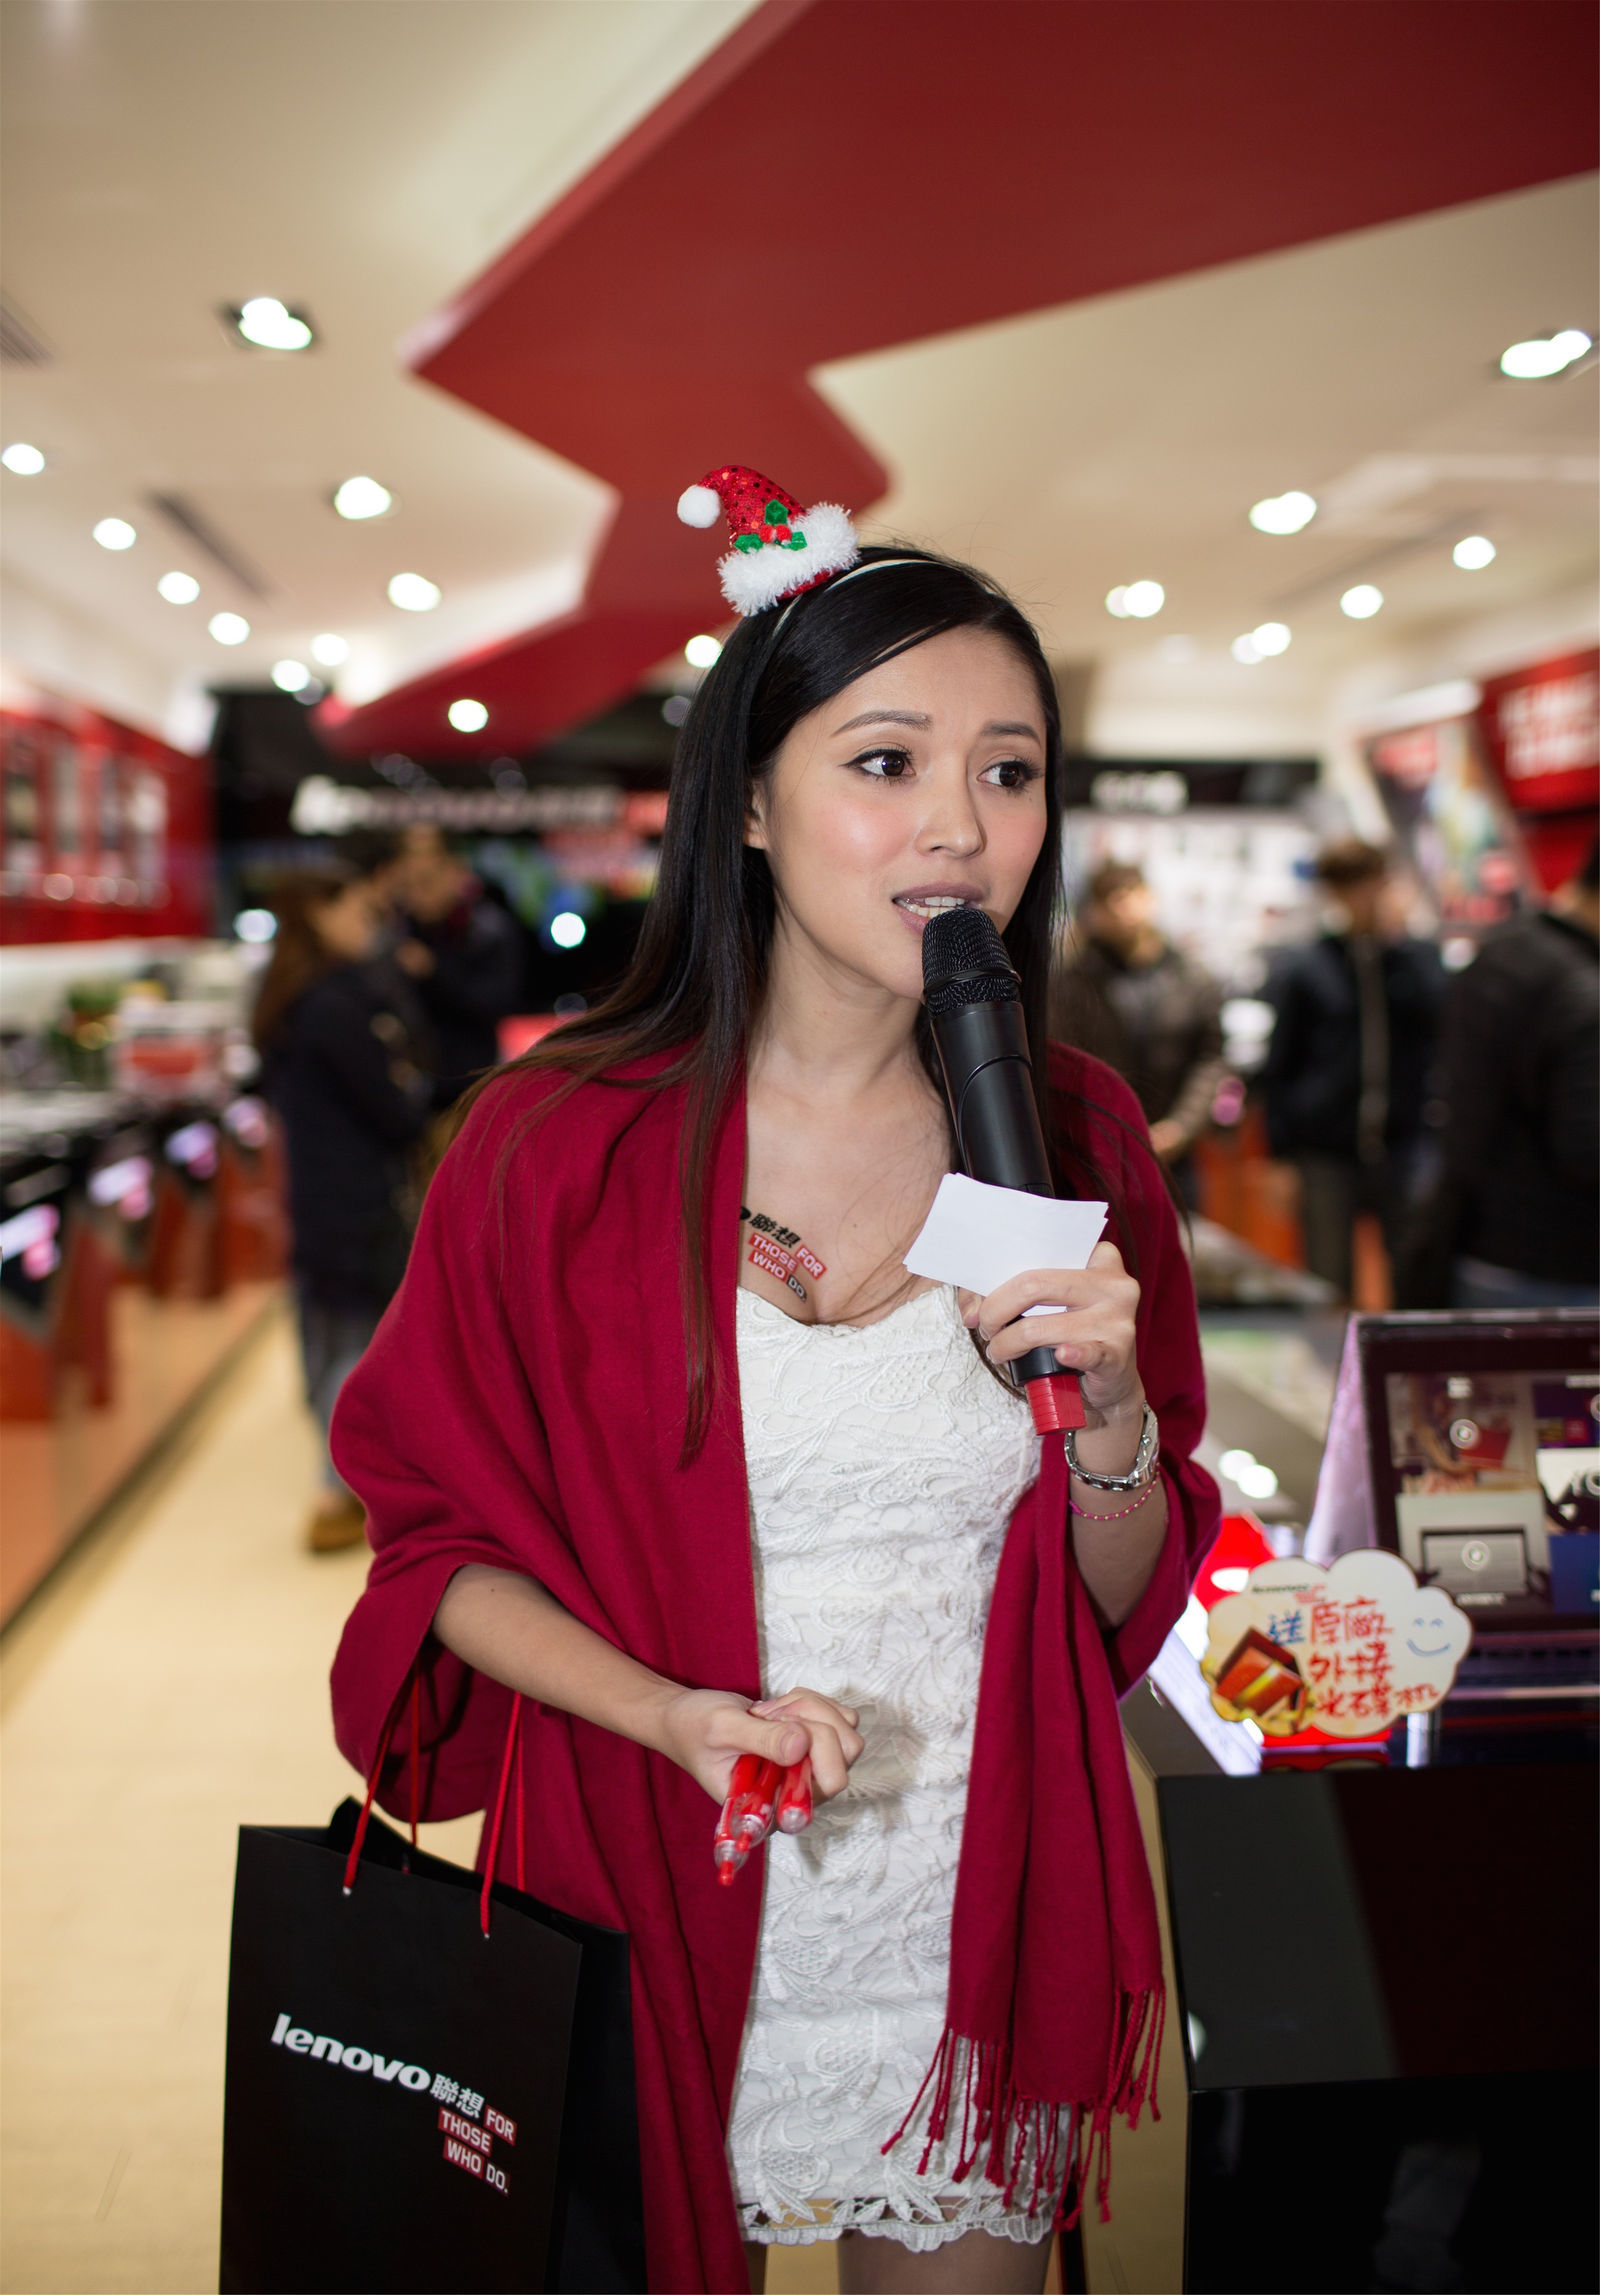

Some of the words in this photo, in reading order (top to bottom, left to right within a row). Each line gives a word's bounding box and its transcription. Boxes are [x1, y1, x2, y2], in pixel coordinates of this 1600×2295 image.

[749, 1213, 801, 1248] 聯想
[796, 1247, 824, 1276] FOR
[753, 1235, 798, 1271] THOSE
[752, 1252, 787, 1279] WHO
[788, 1276, 807, 1303] DO.
[271, 2012, 431, 2091] lenovo
[430, 2073, 485, 2119] 聯想
[486, 2108, 514, 2141] FOR
[442, 2110, 491, 2153] THOSE
[446, 2140, 482, 2174] WHO
[486, 2163, 509, 2194] DO.
